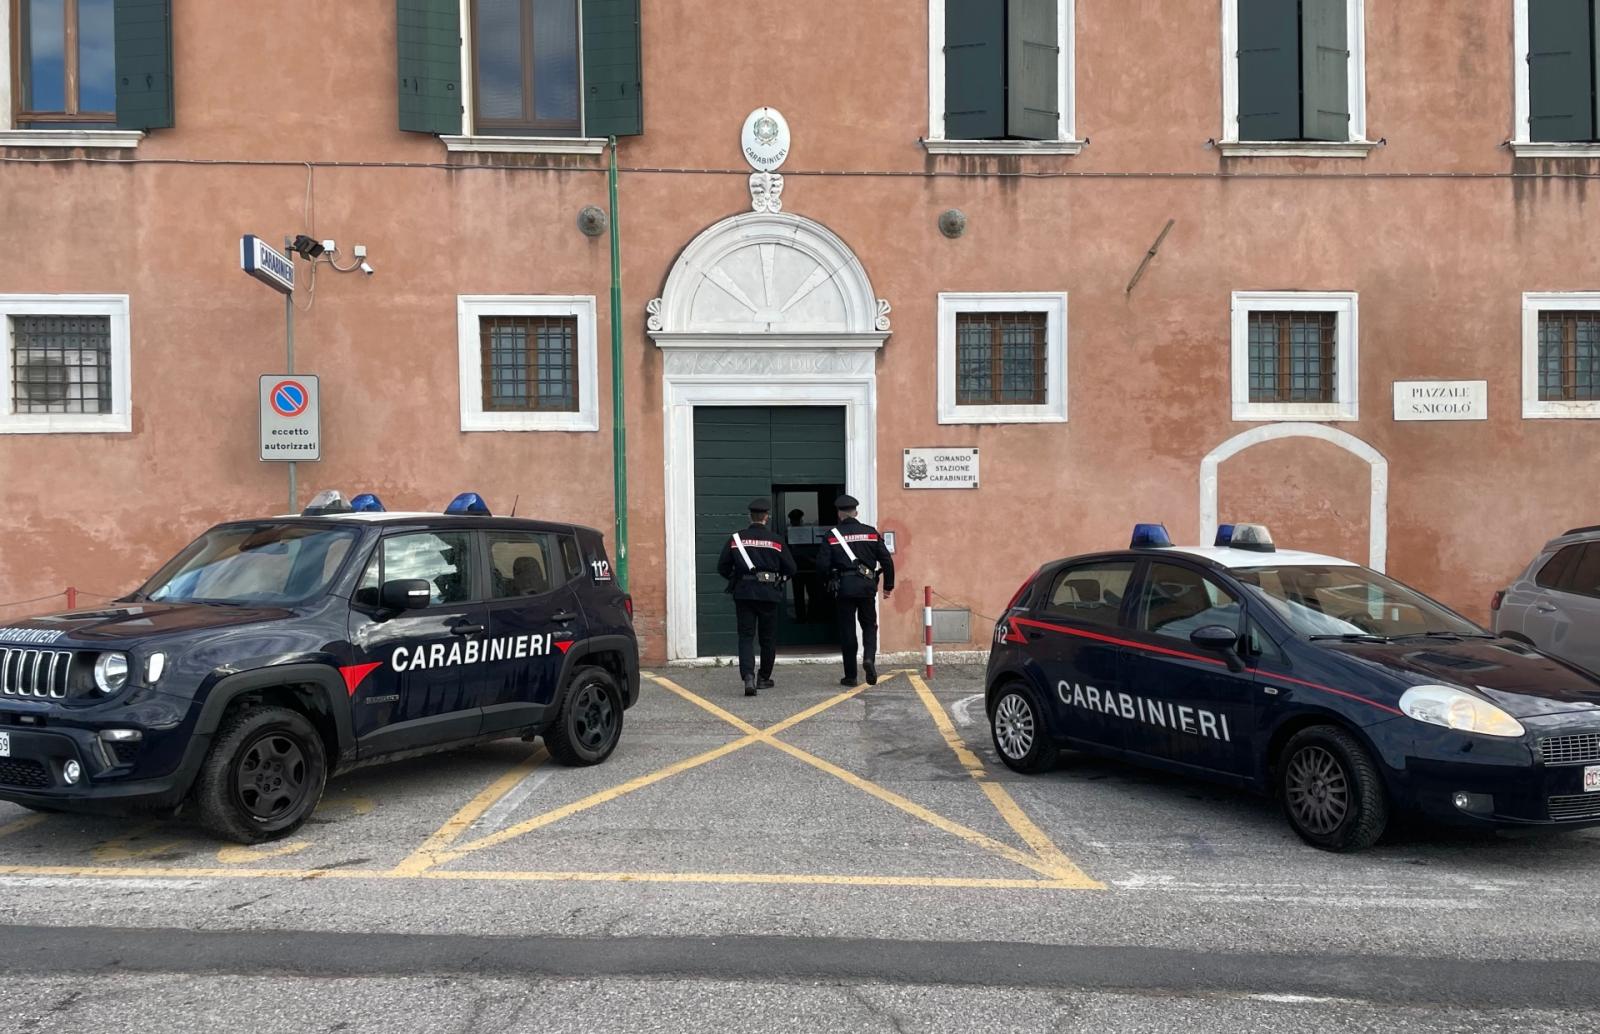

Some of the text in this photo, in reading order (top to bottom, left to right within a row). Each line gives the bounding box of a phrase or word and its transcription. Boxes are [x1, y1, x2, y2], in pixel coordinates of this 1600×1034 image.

[745, 146, 786, 164] CARABINIERI
[1412, 387, 1470, 398] PIAZZALE
[264, 442, 316, 450] autorizzati
[592, 560, 610, 577] 112
[0, 627, 66, 643] ARABINIERI
[391, 633, 552, 672] CARABINIERI
[1057, 680, 1231, 742] CARABINIERI
